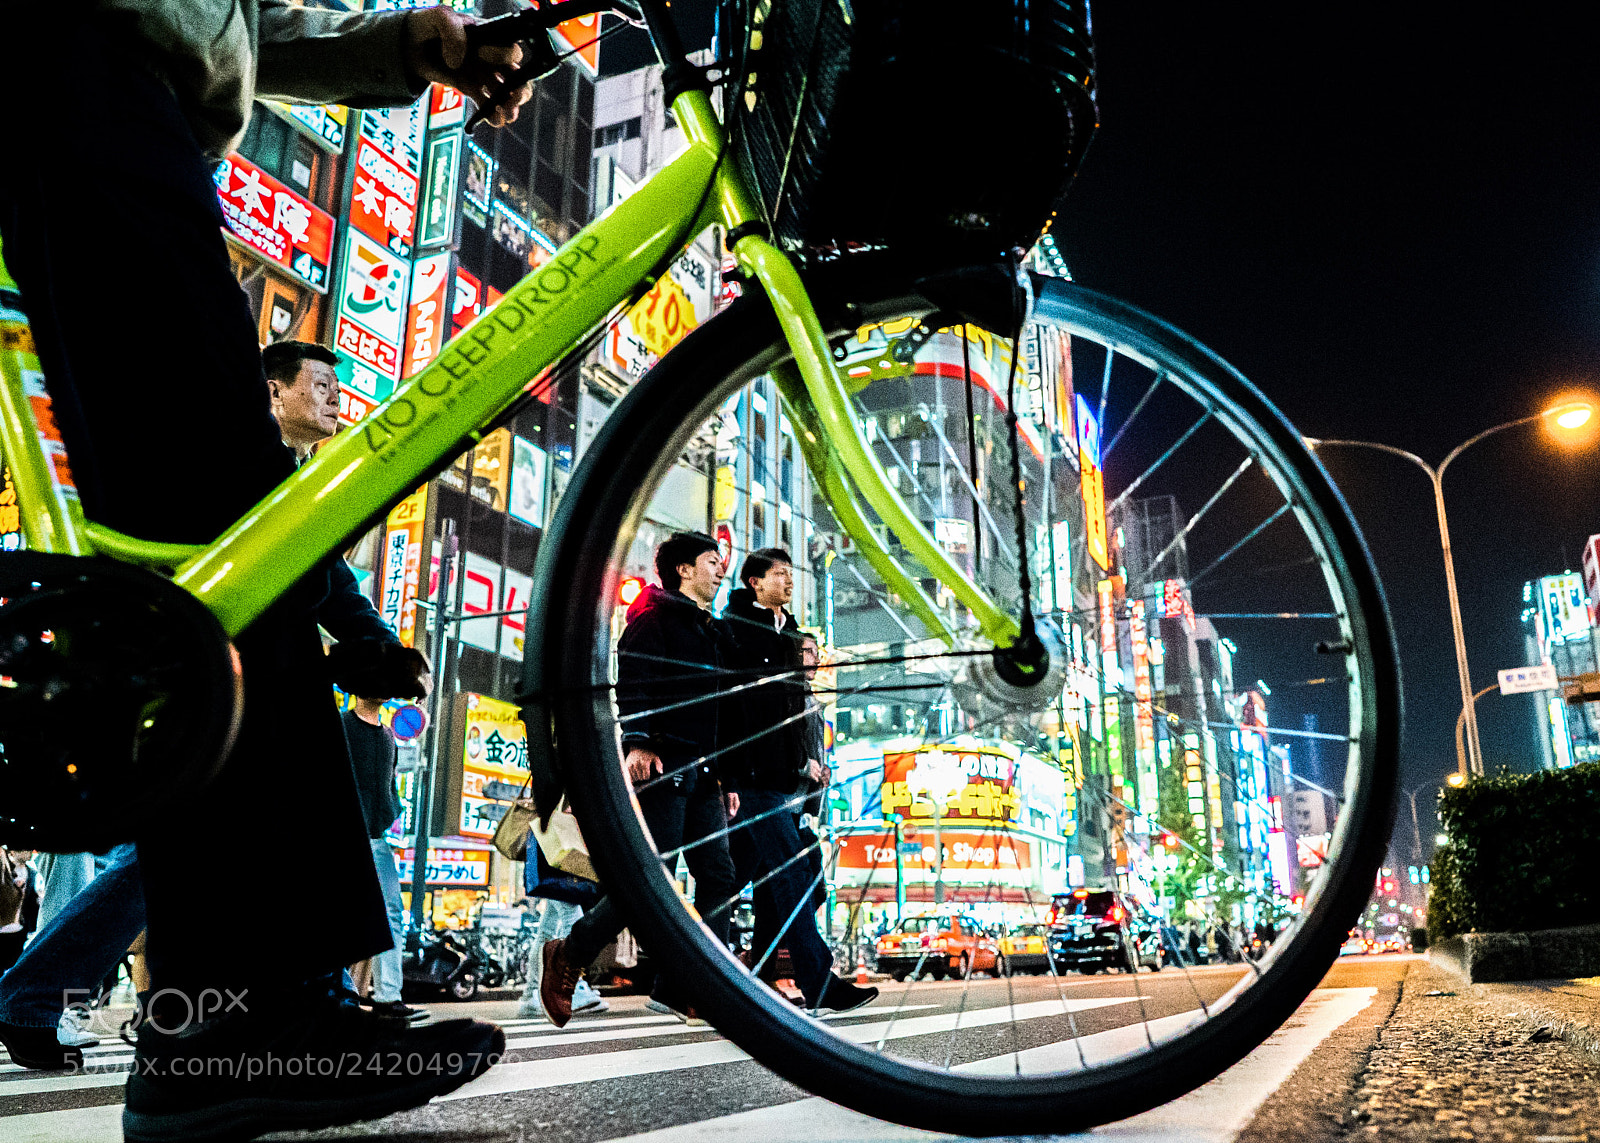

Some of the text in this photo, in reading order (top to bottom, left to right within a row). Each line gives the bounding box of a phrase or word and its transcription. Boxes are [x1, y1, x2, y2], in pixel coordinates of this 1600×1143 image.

[294, 253, 323, 283] 4F
[397, 502, 418, 519] 2F
[953, 842, 995, 866] Shop
